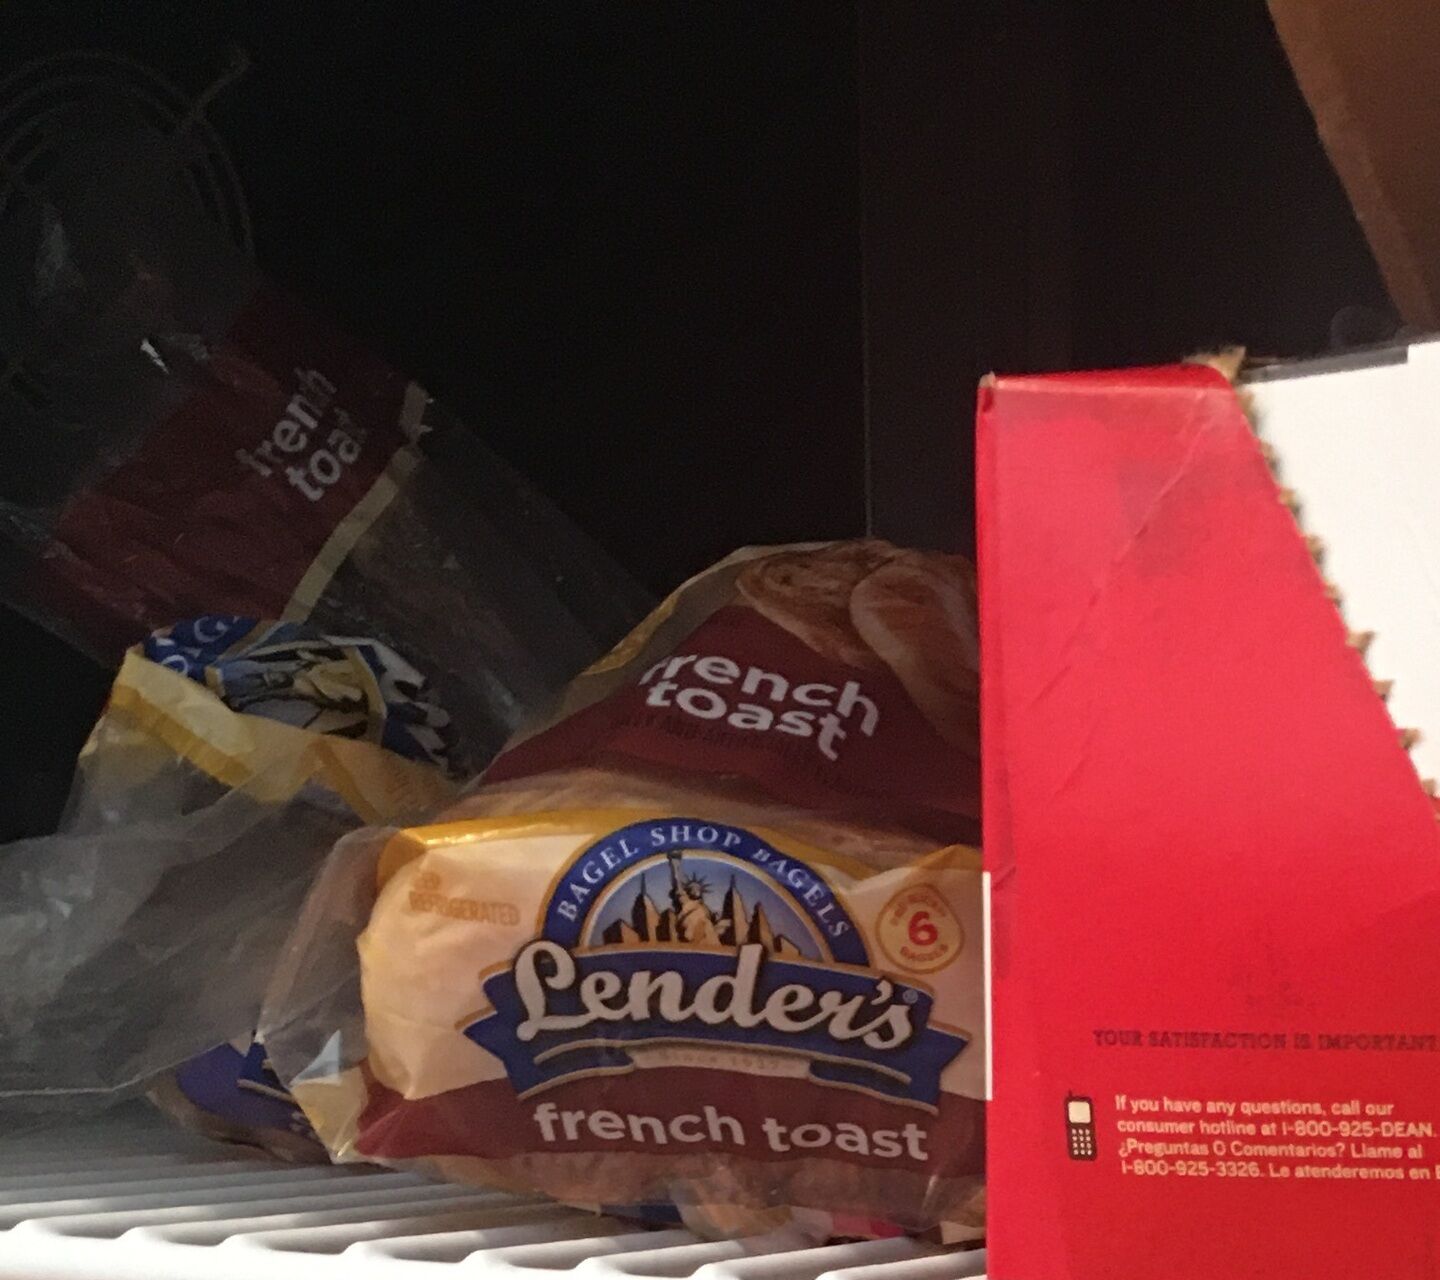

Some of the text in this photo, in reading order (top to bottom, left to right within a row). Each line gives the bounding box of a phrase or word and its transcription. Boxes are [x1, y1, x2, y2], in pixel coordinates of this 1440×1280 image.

[646, 681, 847, 761] toast
[556, 839, 639, 922] BAGEL
[650, 826, 742, 847] SHOP
[753, 848, 850, 938] BAGELS
[907, 911, 938, 946] 6
[510, 938, 914, 1050] Lender's
[1149, 1031, 1286, 1048] SATISFACTION
[1115, 1095, 1394, 1116] If you have any questions, call our
[534, 1101, 929, 1161] french toast
[1118, 1120, 1276, 1136] consumer hotline at
[1231, 1141, 1346, 1158] Comentarios?
[1351, 1143, 1403, 1158] Llame
[1269, 1163, 1290, 1177] Le
[1295, 1164, 1404, 1180] atenderemos
[1409, 1168, 1430, 1178] en
